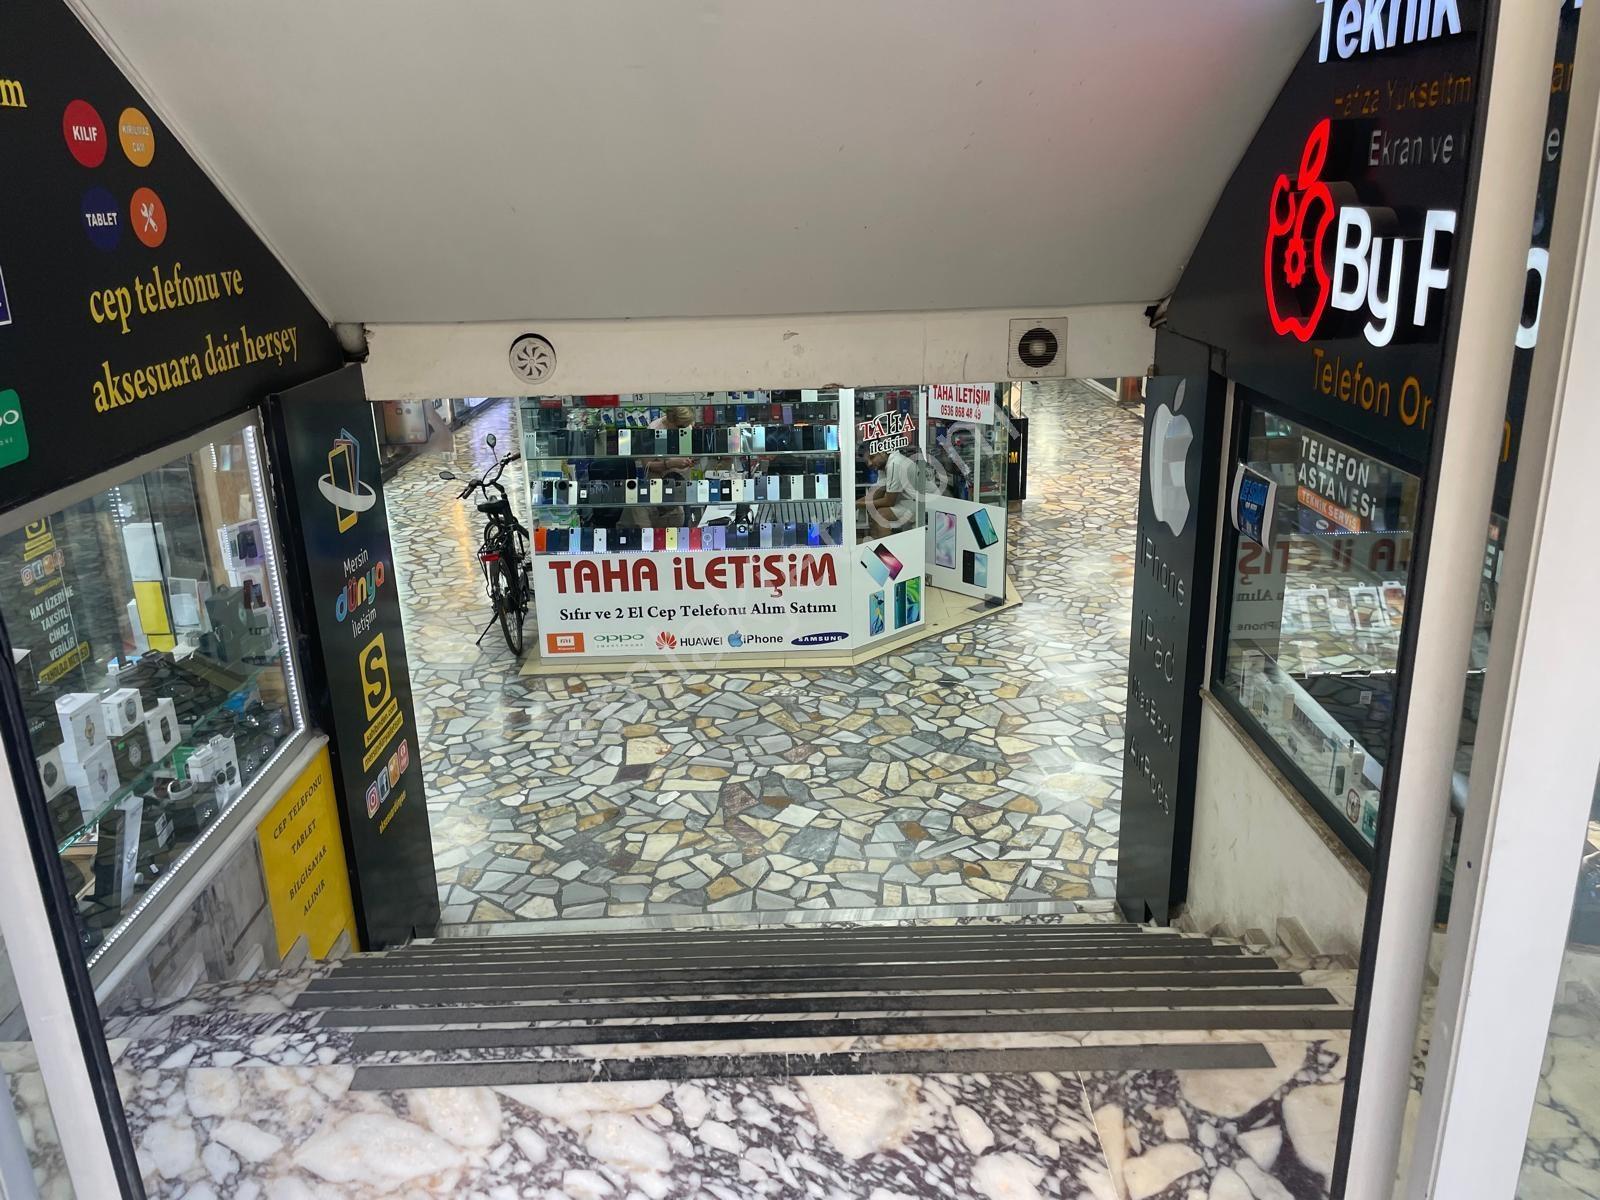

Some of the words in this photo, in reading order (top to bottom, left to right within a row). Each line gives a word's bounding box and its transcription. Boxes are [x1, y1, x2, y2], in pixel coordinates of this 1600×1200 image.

[72, 125, 98, 142] KILIF
[1368, 129, 1423, 166] Ekran
[1431, 134, 1454, 164] ve
[85, 212, 118, 227] TABLET
[1331, 206, 1404, 348] By
[89, 285, 132, 334] cep
[135, 261, 220, 314] telefonu
[220, 268, 245, 297] ve
[92, 360, 203, 413] aksesuara
[204, 333, 241, 377] dair
[240, 325, 297, 367] herşey
[1313, 347, 1390, 417] Telefon
[933, 385, 954, 402] TAHA
[859, 409, 916, 442] TAHA
[1301, 435, 1370, 488] TELEFON
[343, 548, 369, 578] Mersin
[548, 557, 659, 594] TAHA
[335, 561, 385, 623] dünya
[30, 603, 45, 621] HAT
[559, 607, 592, 621] Sıfır
[594, 609, 611, 620] ve
[615, 608, 624, 619] 2
[627, 606, 643, 619] El
[647, 606, 677, 621] Cep
[679, 604, 746, 618] Telefonu
[751, 602, 786, 615] Alım
[790, 602, 837, 614] Satımı
[680, 636, 723, 647] HUAWEI
[743, 633, 784, 644] iPhone
[1139, 609, 1175, 683] iPad
[272, 818, 288, 841] CEP
[287, 774, 323, 822] TELEFONU
[290, 818, 318, 856] TABLET
[289, 845, 328, 901] BİLGİSAYAR
[303, 878, 326, 917] ALINIR
